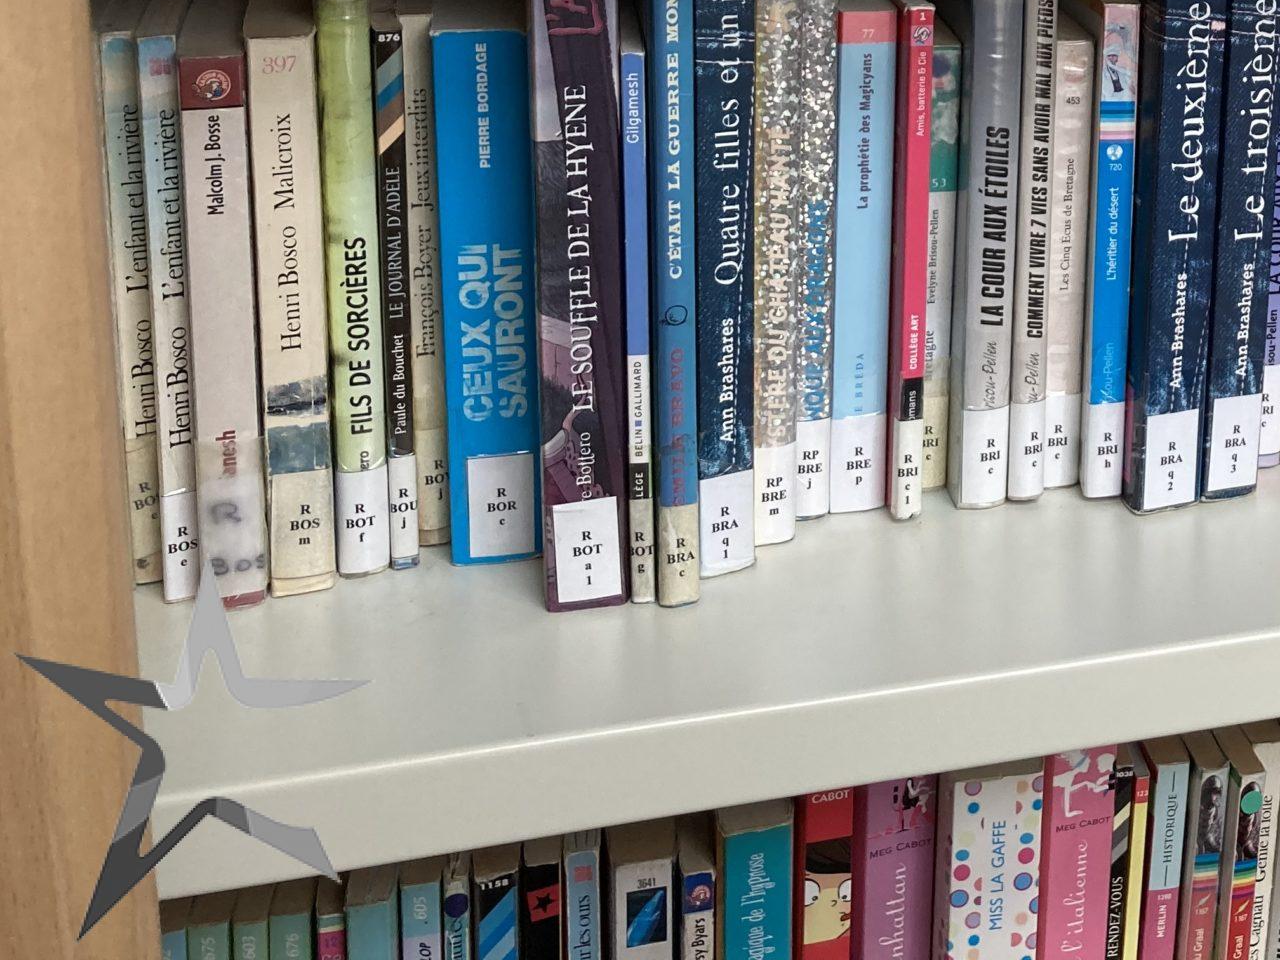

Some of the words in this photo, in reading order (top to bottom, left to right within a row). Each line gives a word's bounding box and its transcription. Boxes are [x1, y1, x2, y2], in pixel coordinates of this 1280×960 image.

[721, 14, 740, 49] un
[262, 56, 296, 74] 397
[476, 43, 487, 112] BORDAGE
[721, 58, 740, 83] et
[626, 72, 638, 144] Gilgamesh
[666, 54, 680, 155] GUERRE
[1172, 2, 1211, 183] deuxième
[204, 115, 221, 151] Bosse
[480, 117, 491, 169] PIERRE
[714, 98, 740, 170] filles
[270, 113, 295, 210] Malicroix
[667, 161, 681, 190] LA
[978, 126, 1010, 195] ÉTOILES
[206, 168, 224, 215] Malcolm
[567, 186, 593, 218] LA
[714, 184, 741, 285] Quatre
[983, 202, 1006, 241] AUX
[1168, 195, 1199, 242] Le
[1235, 195, 1265, 241] Le
[278, 226, 298, 288] Bosco
[568, 224, 590, 259] DE
[340, 238, 369, 351] SORCIÈRES
[457, 244, 489, 310] QUI
[981, 247, 1004, 300] COUR
[277, 292, 301, 352] Henri
[569, 265, 597, 377] SOUFFLE
[980, 306, 1004, 326] LA
[1237, 263, 1253, 341] Brashares
[492, 243, 528, 419] SAURONT
[350, 360, 370, 390] DE
[391, 333, 405, 382] Bouchet
[461, 319, 493, 421] CEUX
[1235, 344, 1247, 377] Ann
[351, 396, 373, 435] FILS
[394, 386, 405, 407] du
[572, 381, 595, 412] LE
[395, 410, 405, 435] Paule
[1160, 454, 1183, 465] BRA
[761, 490, 787, 502] BRE
[767, 478, 782, 487] RP
[290, 519, 320, 531] BOS
[488, 501, 517, 512] BOR
[572, 543, 602, 556] BOT
[812, 791, 849, 804] CABOT
[991, 820, 1007, 869] GAFFE
[1164, 793, 1178, 862] HISTORIQUE
[991, 872, 1004, 898] LA
[990, 902, 1003, 931] MISS
